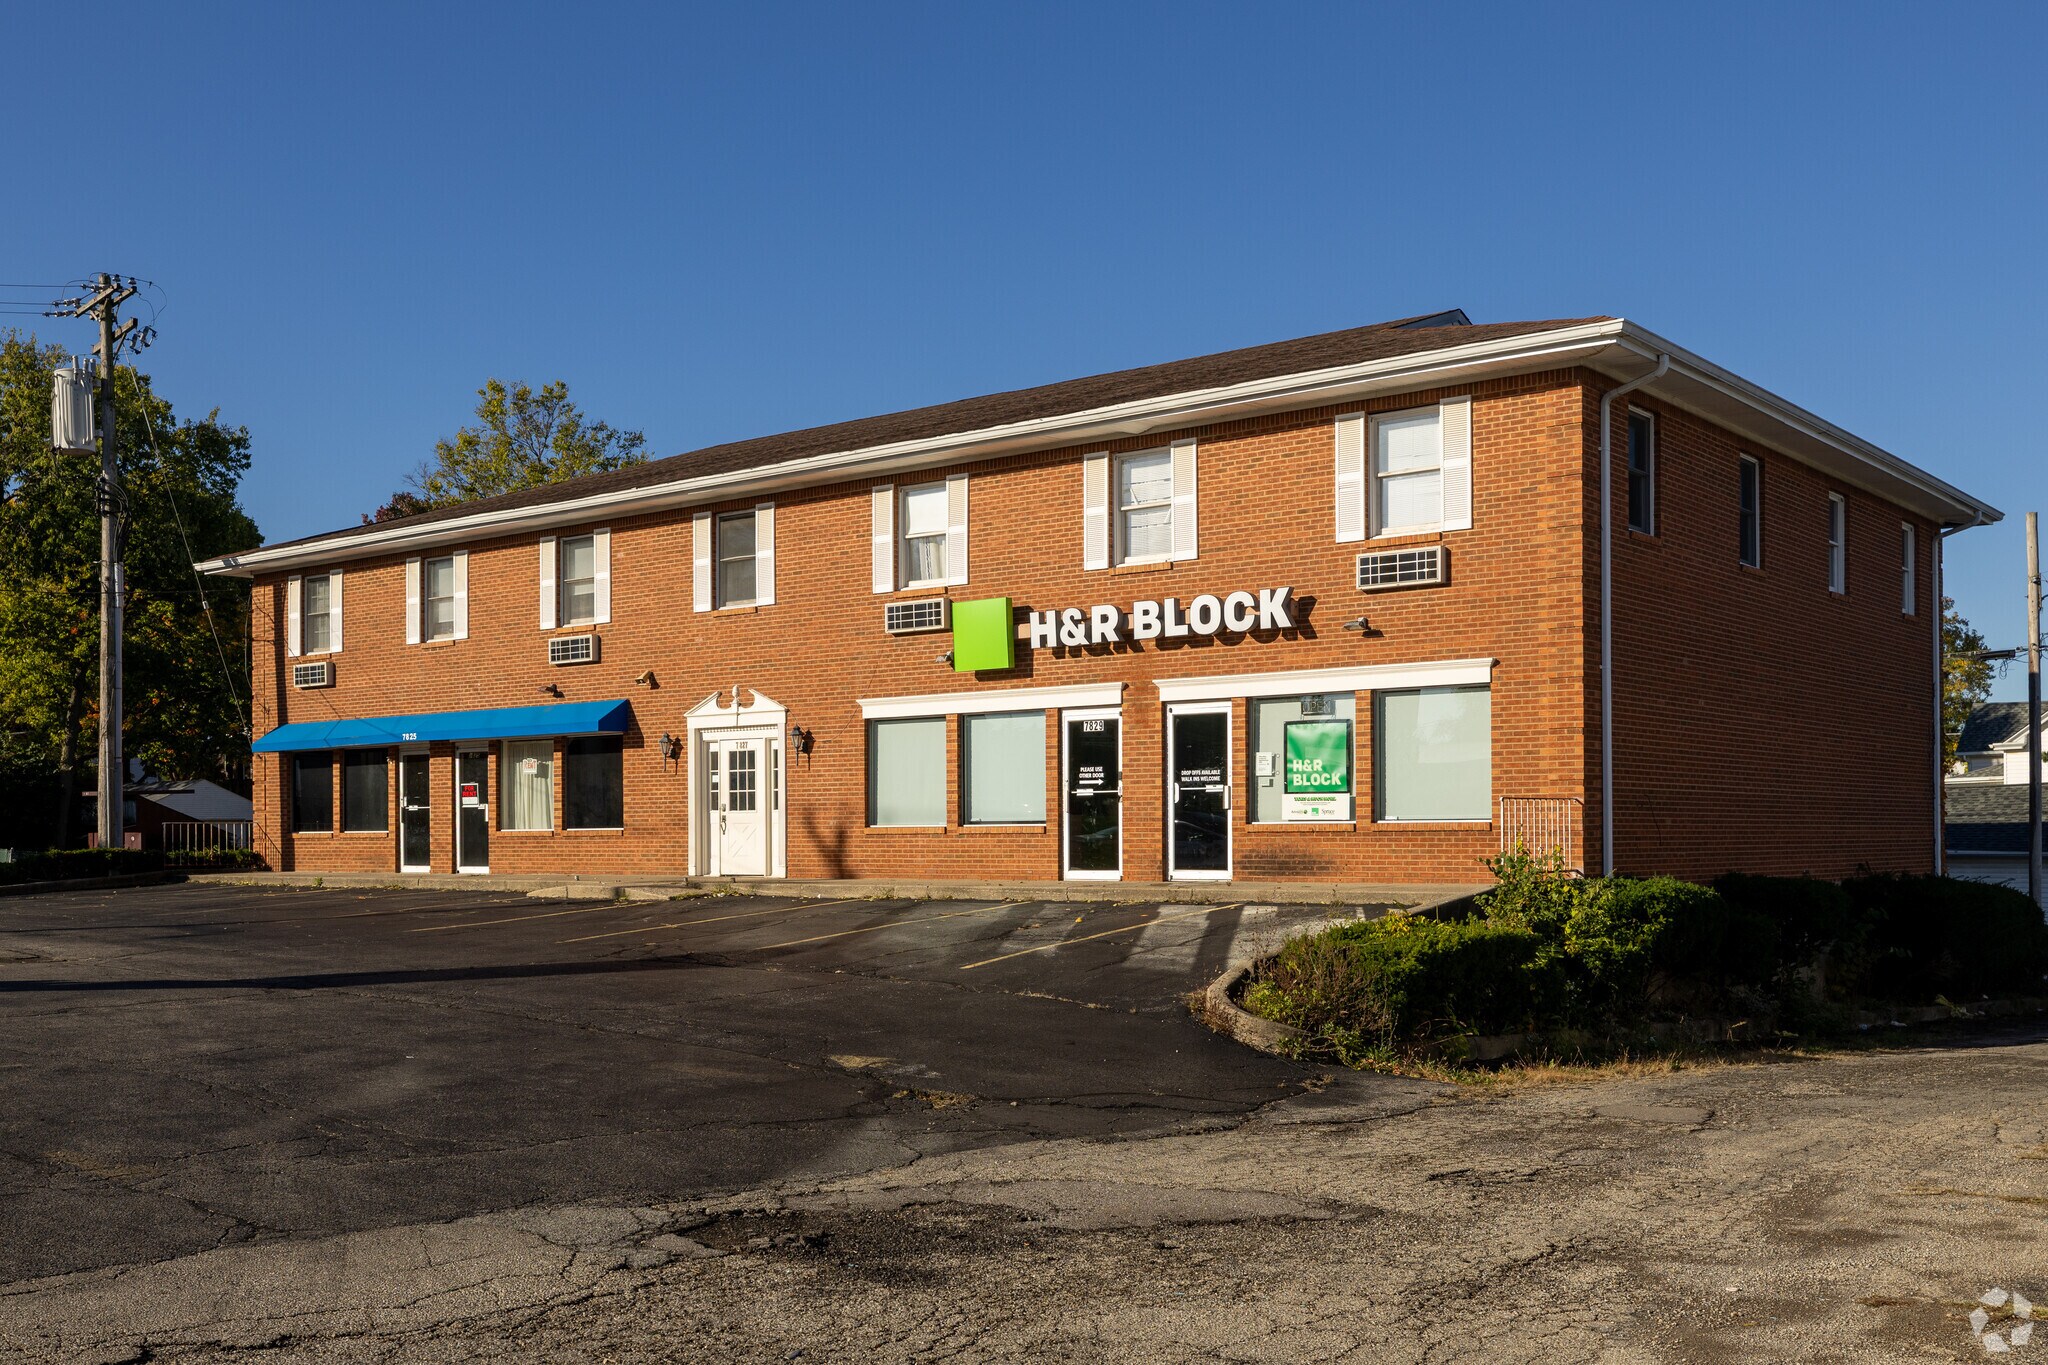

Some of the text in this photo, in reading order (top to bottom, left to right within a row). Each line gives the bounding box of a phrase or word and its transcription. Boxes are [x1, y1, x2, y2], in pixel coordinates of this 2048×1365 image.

[1029, 586, 1295, 650] H&R BLOCK
[1083, 720, 1104, 732] 7829
[402, 733, 417, 741] 7825
[1292, 759, 1323, 772] H&R
[1292, 773, 1342, 786] BLOCK
